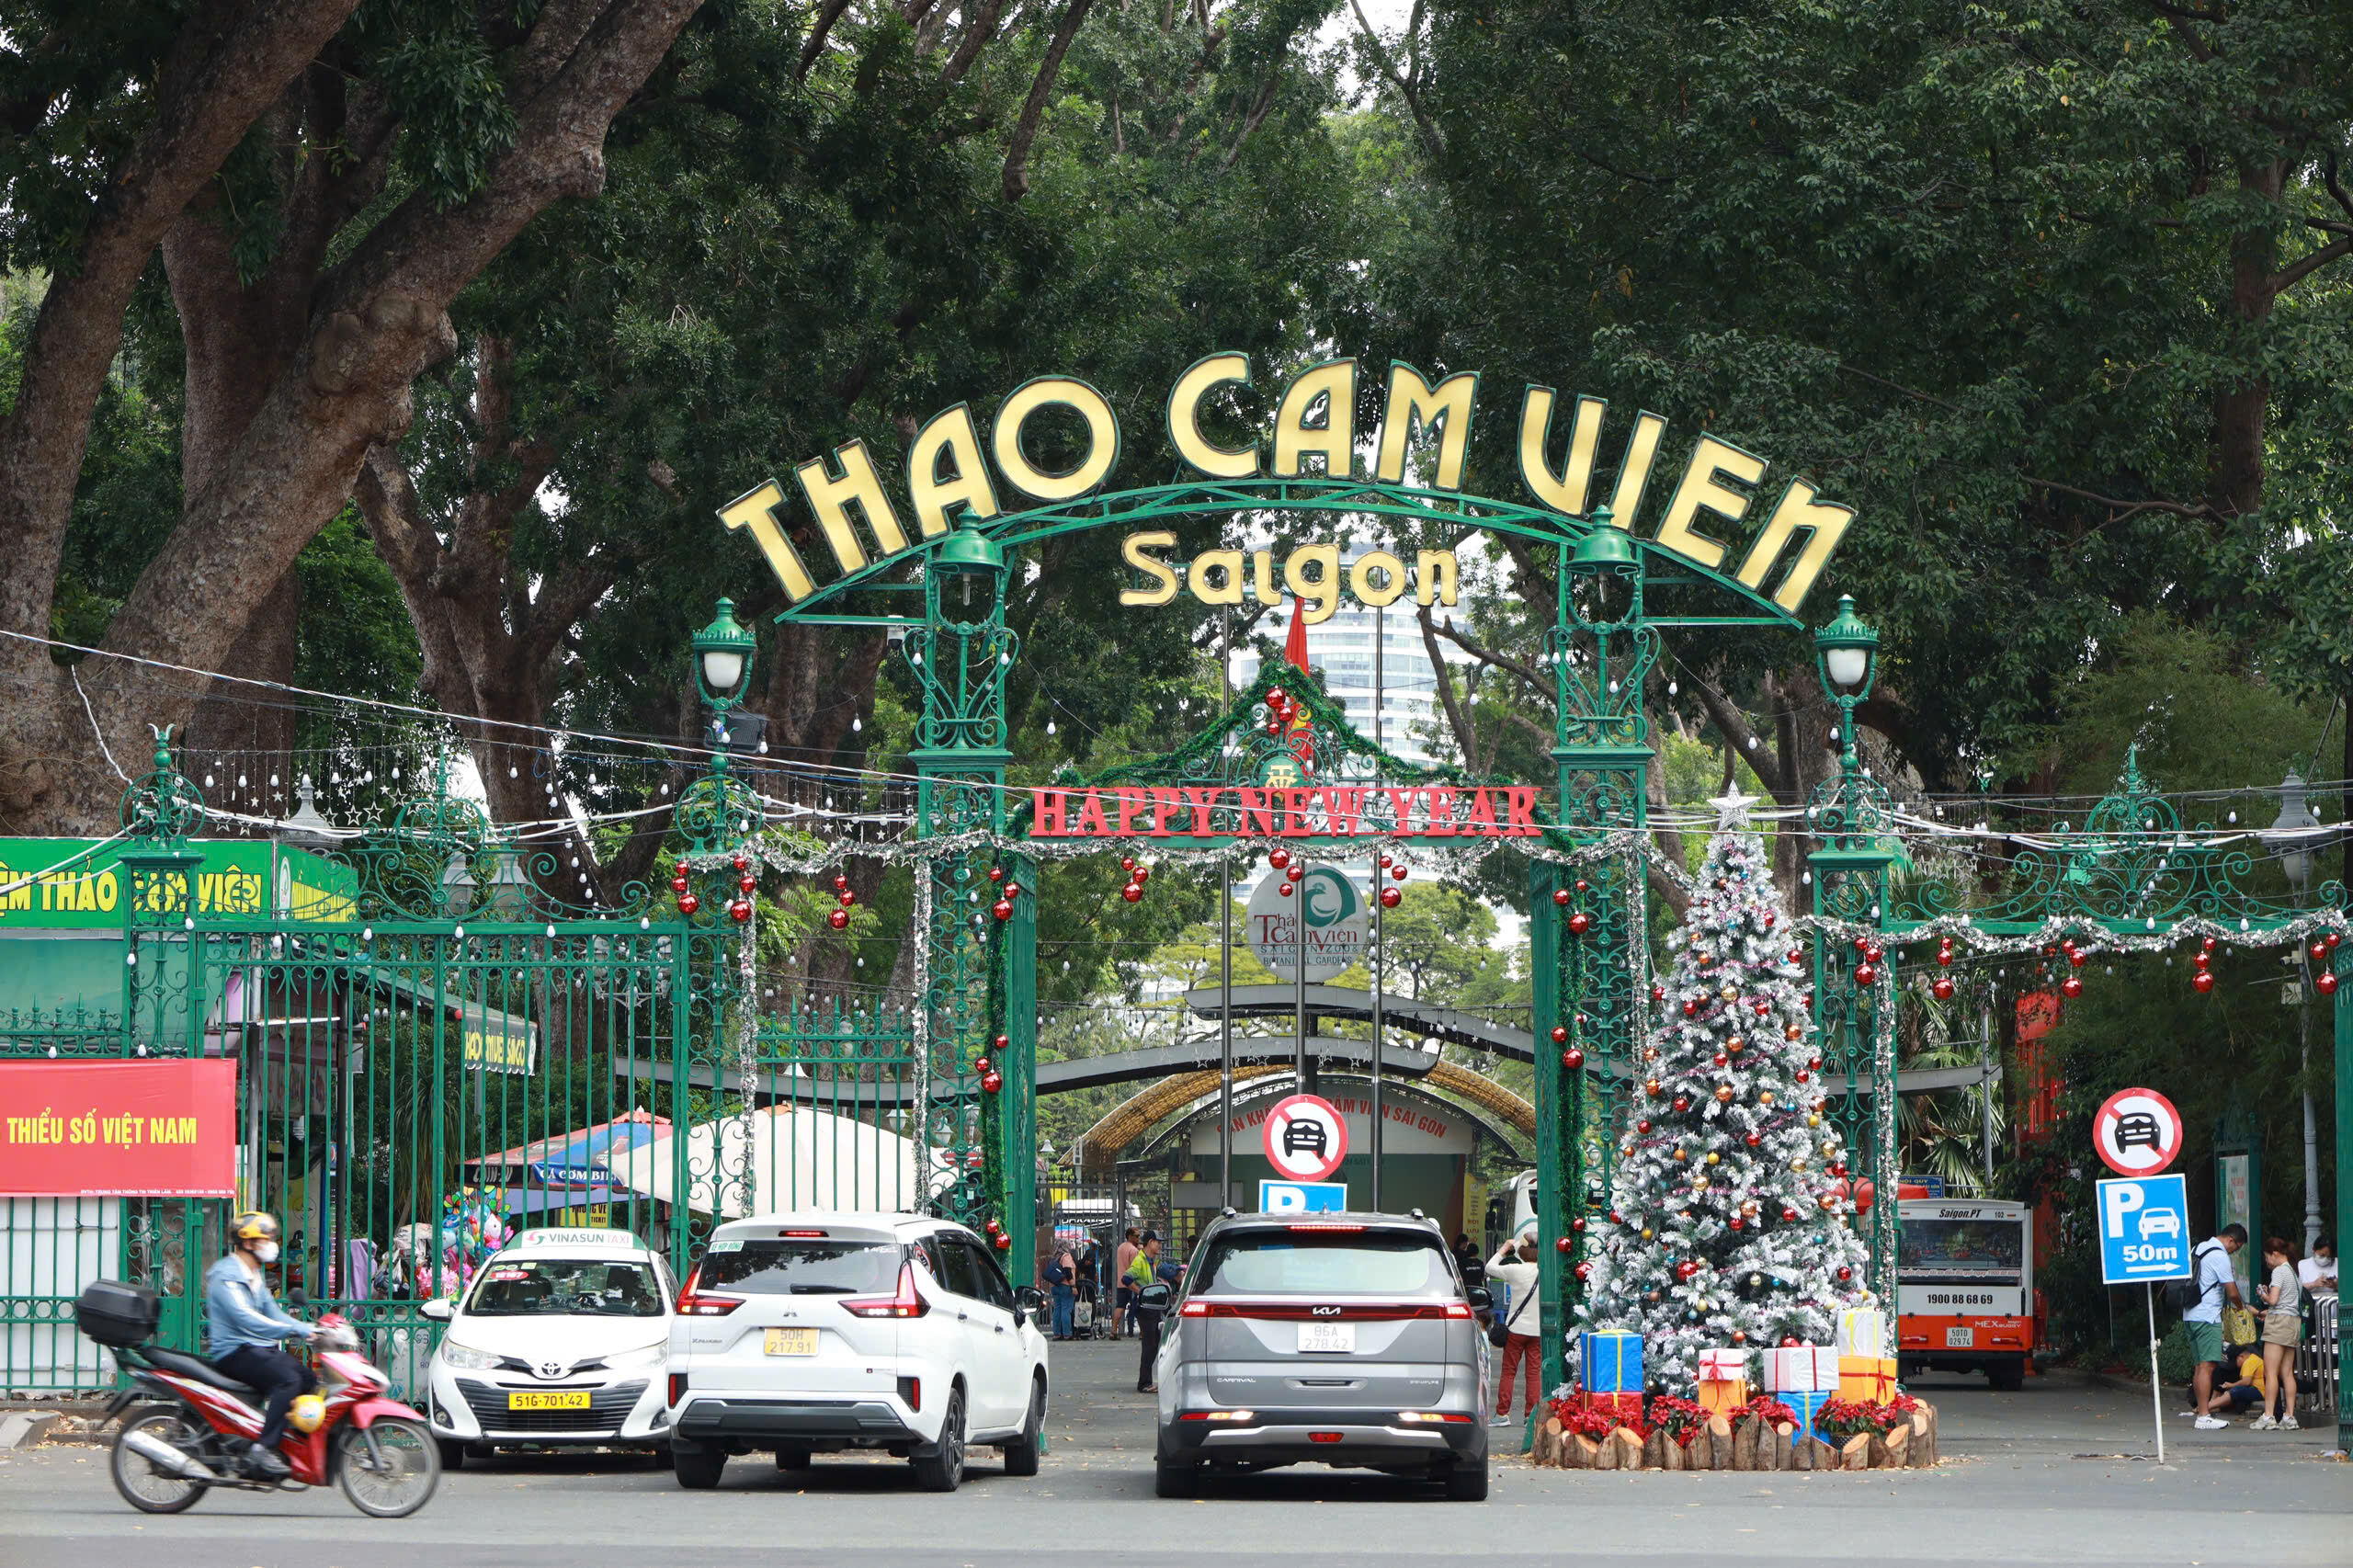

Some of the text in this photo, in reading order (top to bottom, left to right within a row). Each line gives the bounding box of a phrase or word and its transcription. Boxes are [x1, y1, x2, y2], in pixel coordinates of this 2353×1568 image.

[716, 350, 1859, 619] THAO CAM VIEN
[1119, 530, 1459, 626] Saigon
[1029, 785, 1542, 837] HAPPY NEW YEAR
[1260, 944, 1318, 954] SAIGN
[7, 1107, 197, 1149] THIỂU SỐ VIỆT NAM
[2105, 1183, 2144, 1239] P
[549, 1233, 630, 1244] VINASUN TAXI
[2123, 1244, 2177, 1263] 50m
[1927, 1294, 1993, 1304] 1900 88 68 69
